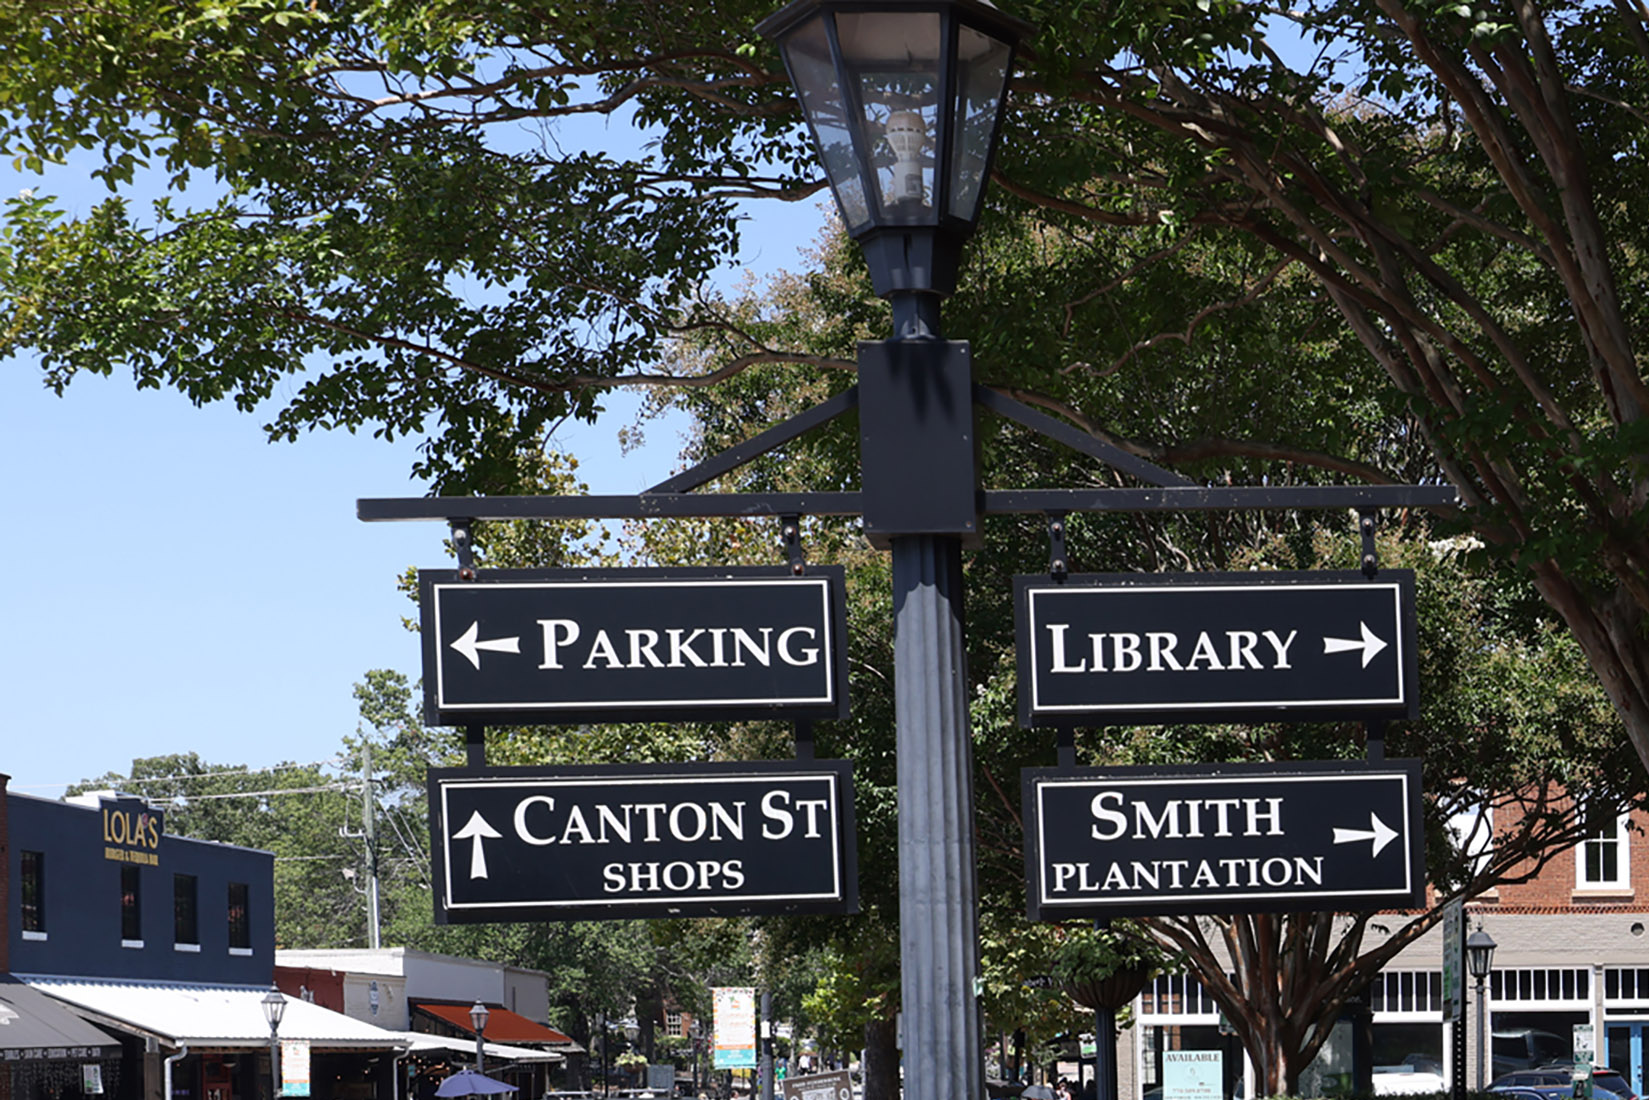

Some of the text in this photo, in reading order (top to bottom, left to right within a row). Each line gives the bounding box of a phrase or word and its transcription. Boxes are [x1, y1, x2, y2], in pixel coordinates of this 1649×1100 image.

[536, 618, 820, 670] PARKING
[1046, 623, 1297, 674] LIBRARY
[513, 790, 828, 846] CANTON ST
[1090, 791, 1285, 841] SMITH
[603, 860, 745, 892] SHOPS
[1052, 857, 1324, 892] PLANTATION
[1165, 1053, 1220, 1062] AVAILABLE
